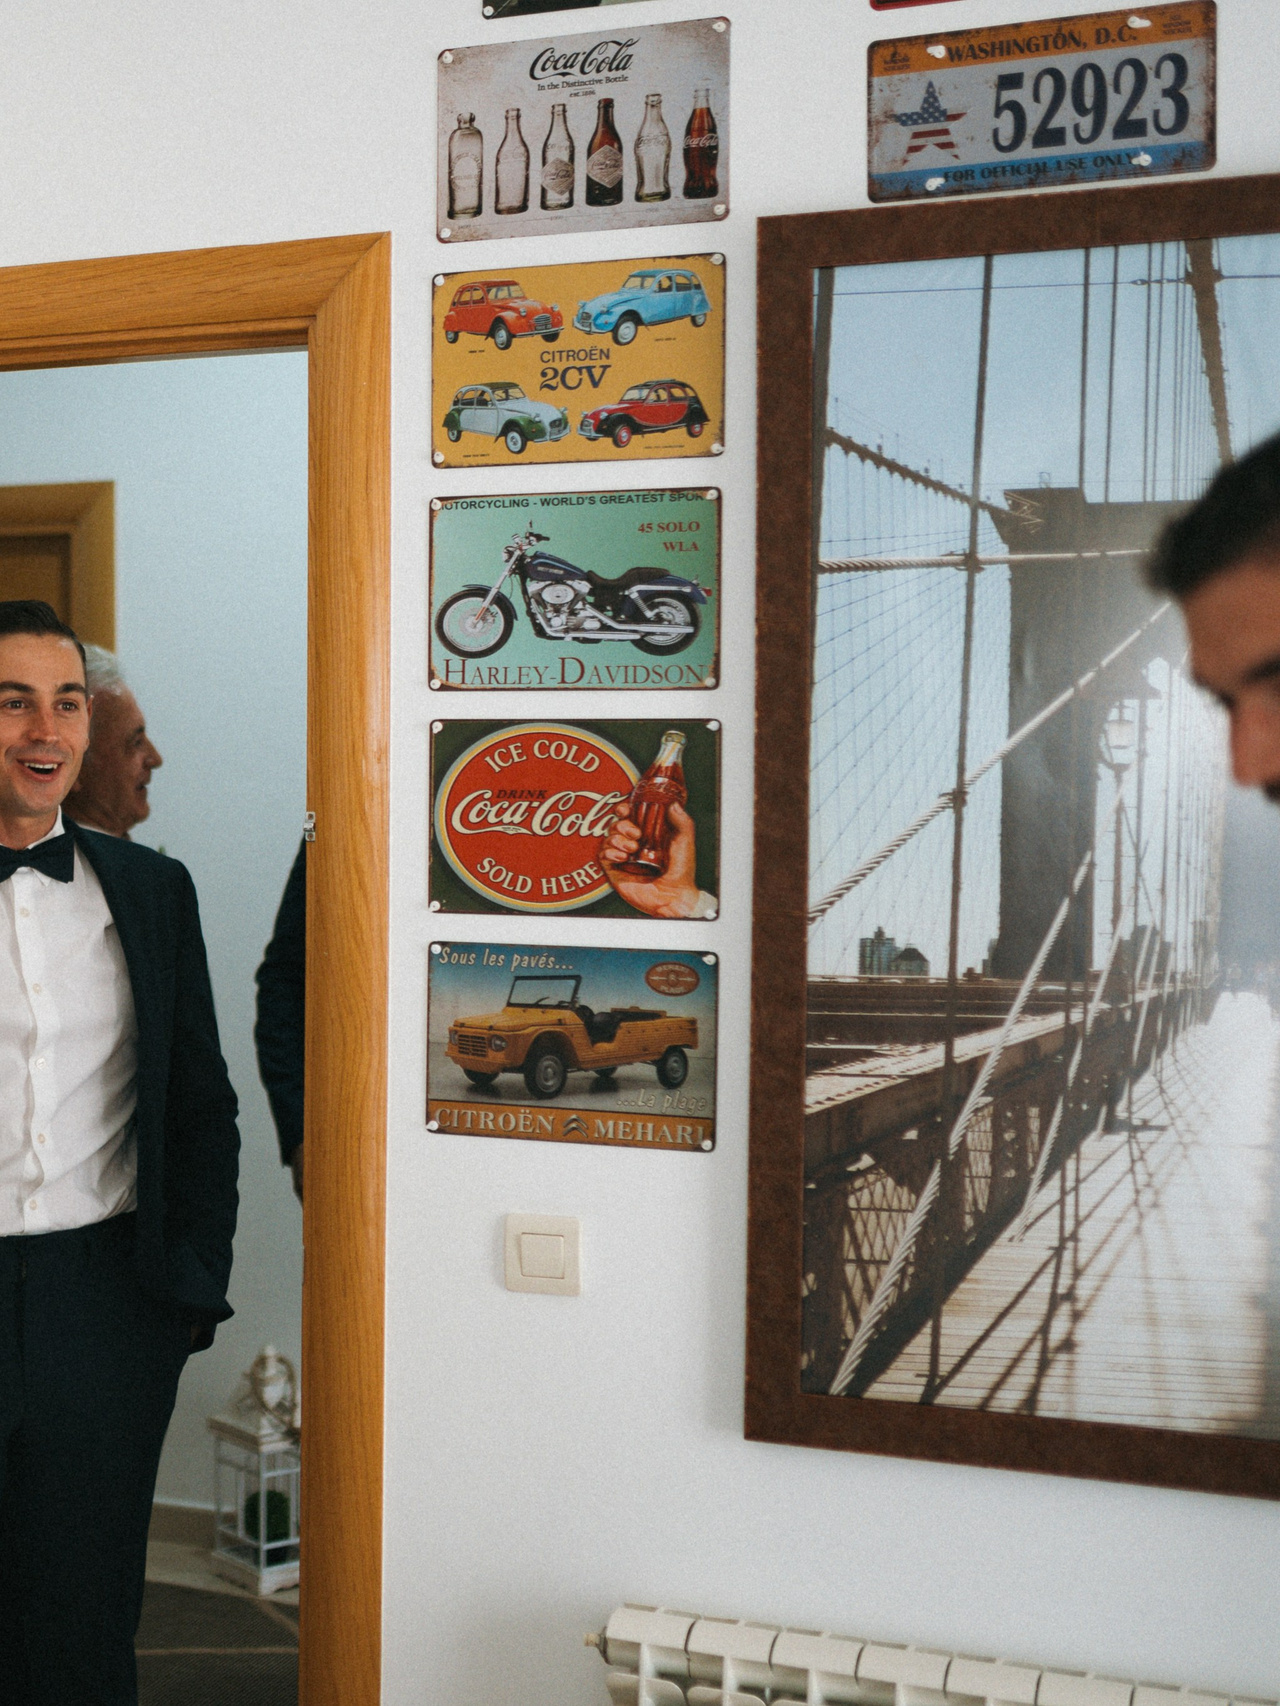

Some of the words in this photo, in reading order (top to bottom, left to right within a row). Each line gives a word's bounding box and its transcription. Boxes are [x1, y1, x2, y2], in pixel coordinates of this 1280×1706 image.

[947, 30, 1087, 62] WASHINGTON,
[1095, 25, 1137, 45] D.C.
[529, 37, 640, 80] Coca-Cola
[547, 82, 559, 90] the
[561, 78, 603, 88] Distinctive
[605, 75, 628, 84] Bottle
[992, 53, 1190, 153] 52923
[943, 168, 975, 183] FOR
[980, 161, 1051, 179] OFFICIAL
[1056, 156, 1087, 171] USE
[540, 346, 610, 363] CITROËN
[539, 364, 611, 391] 2CV
[540, 495, 597, 507] WORLD'S
[599, 493, 665, 505] GREATEST
[669, 492, 706, 502] SPOR
[638, 522, 653, 534] 45
[657, 521, 700, 533] SOLO
[663, 541, 700, 552] WLA
[484, 742, 527, 773] ICE
[533, 739, 601, 773] COLD
[496, 789, 549, 800] DRINK
[451, 789, 631, 838] Coca-Cola
[477, 857, 532, 894] SOLD
[541, 861, 604, 896] HERE
[439, 946, 476, 965] Sous
[483, 948, 505, 966] les
[661, 1090, 708, 1115] plage
[434, 1108, 555, 1134] CITROËN
[594, 1119, 705, 1146] MEHARI
